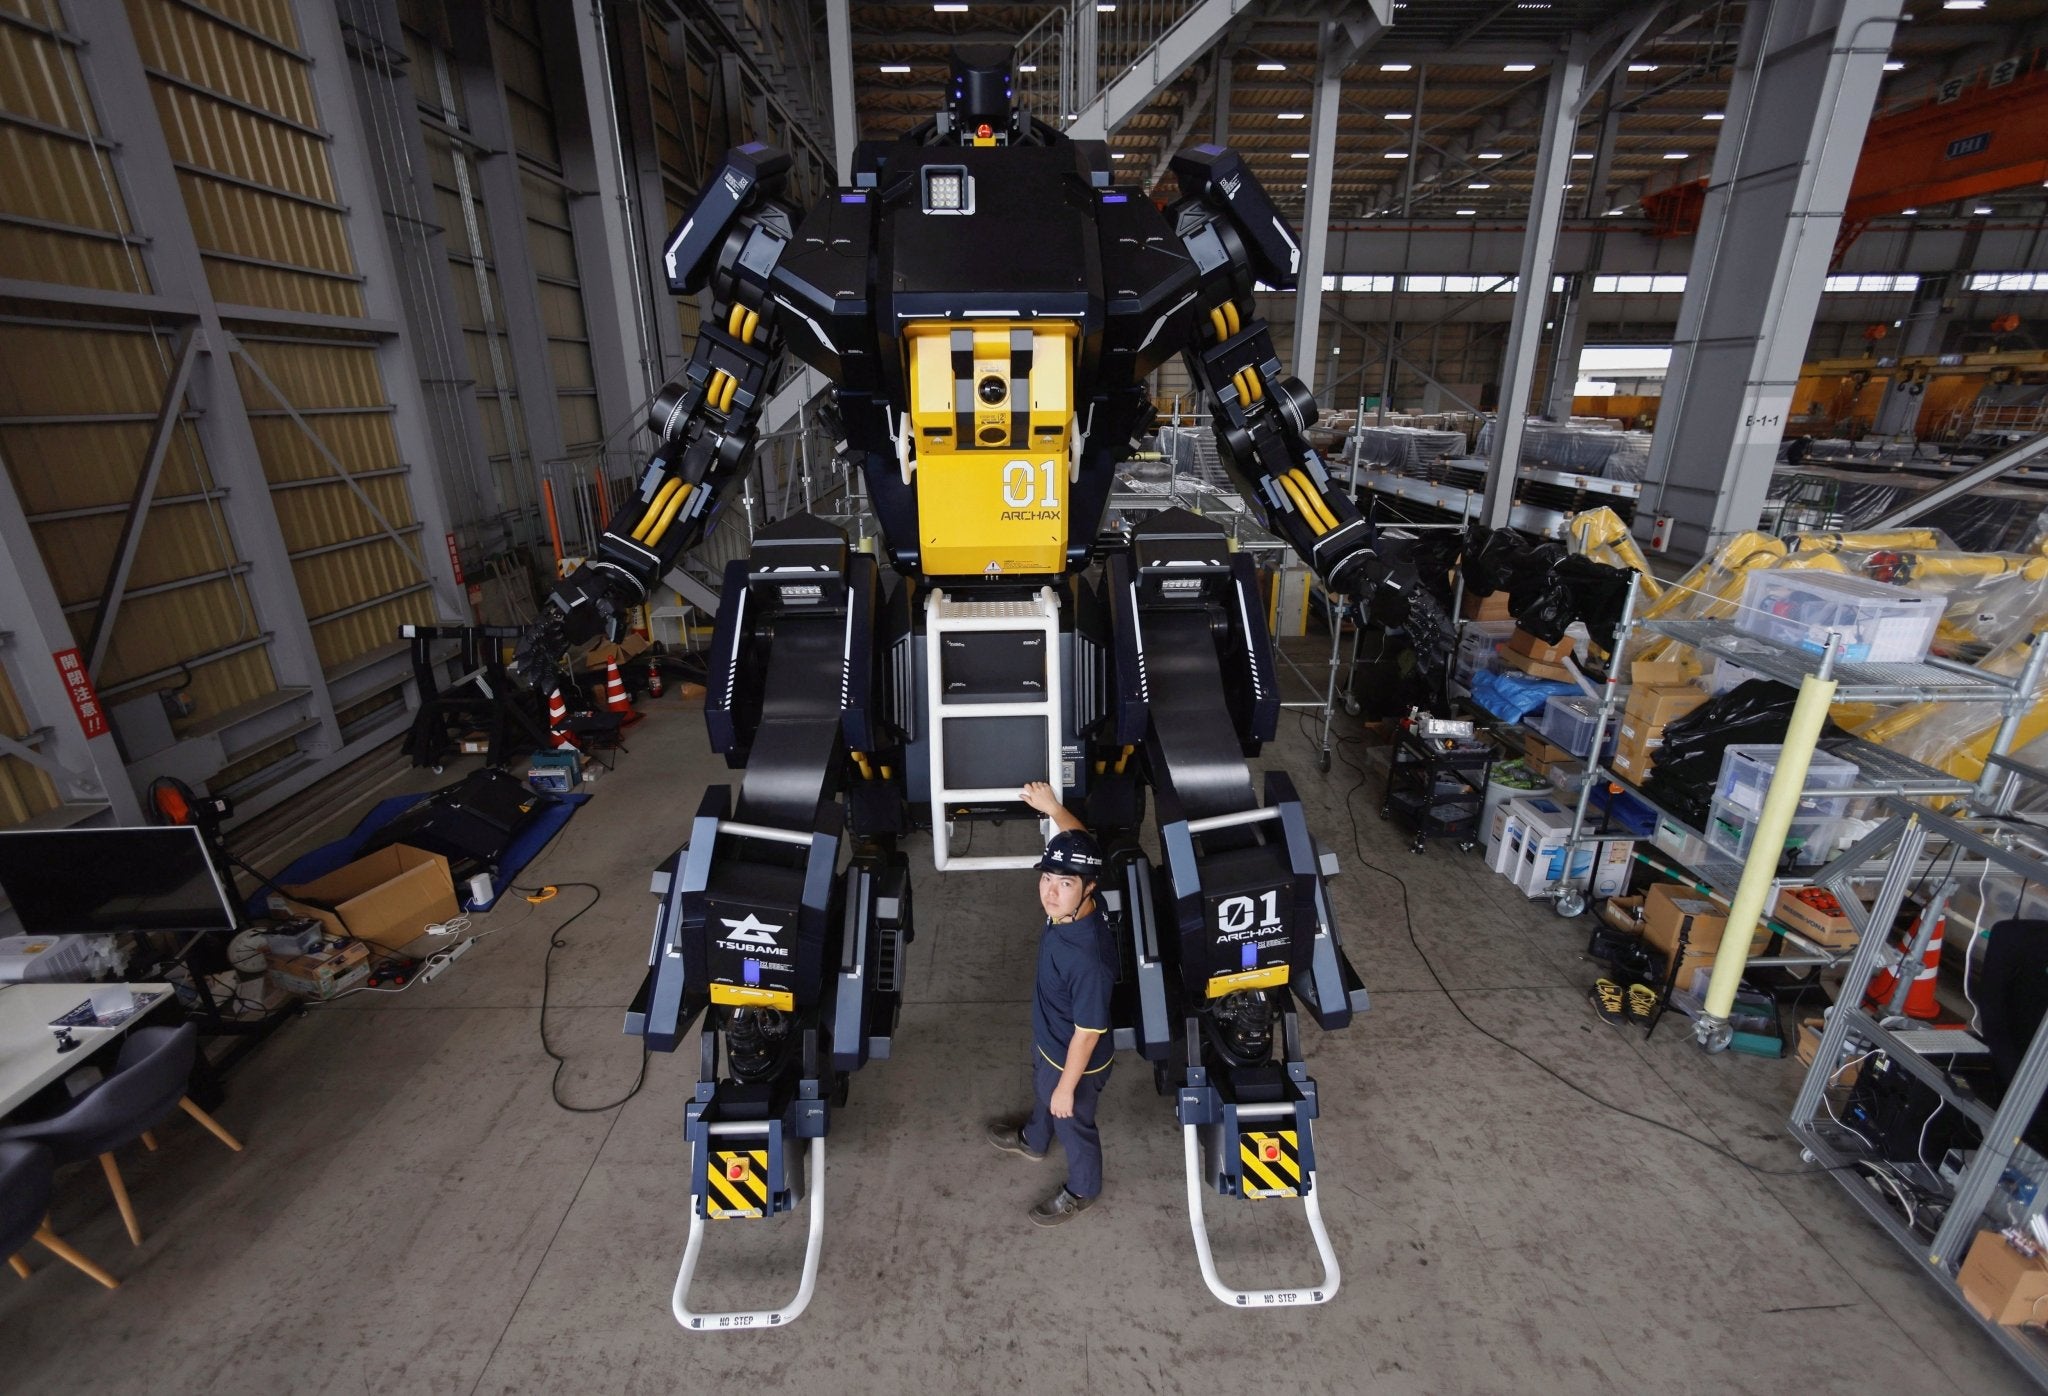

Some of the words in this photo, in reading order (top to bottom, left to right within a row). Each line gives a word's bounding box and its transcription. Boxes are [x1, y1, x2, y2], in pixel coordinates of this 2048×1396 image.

[1951, 138, 1983, 156] IHI
[1003, 460, 1059, 508] 01
[1001, 511, 1060, 521] ARCHAX
[1218, 890, 1280, 933] 01
[1216, 925, 1283, 944] ARCHAX
[716, 940, 788, 956] TSUBAME
[1264, 1294, 1274, 1303] NO
[1278, 1293, 1297, 1302] STEP
[720, 1317, 730, 1326] NO
[734, 1316, 754, 1326] STEP
